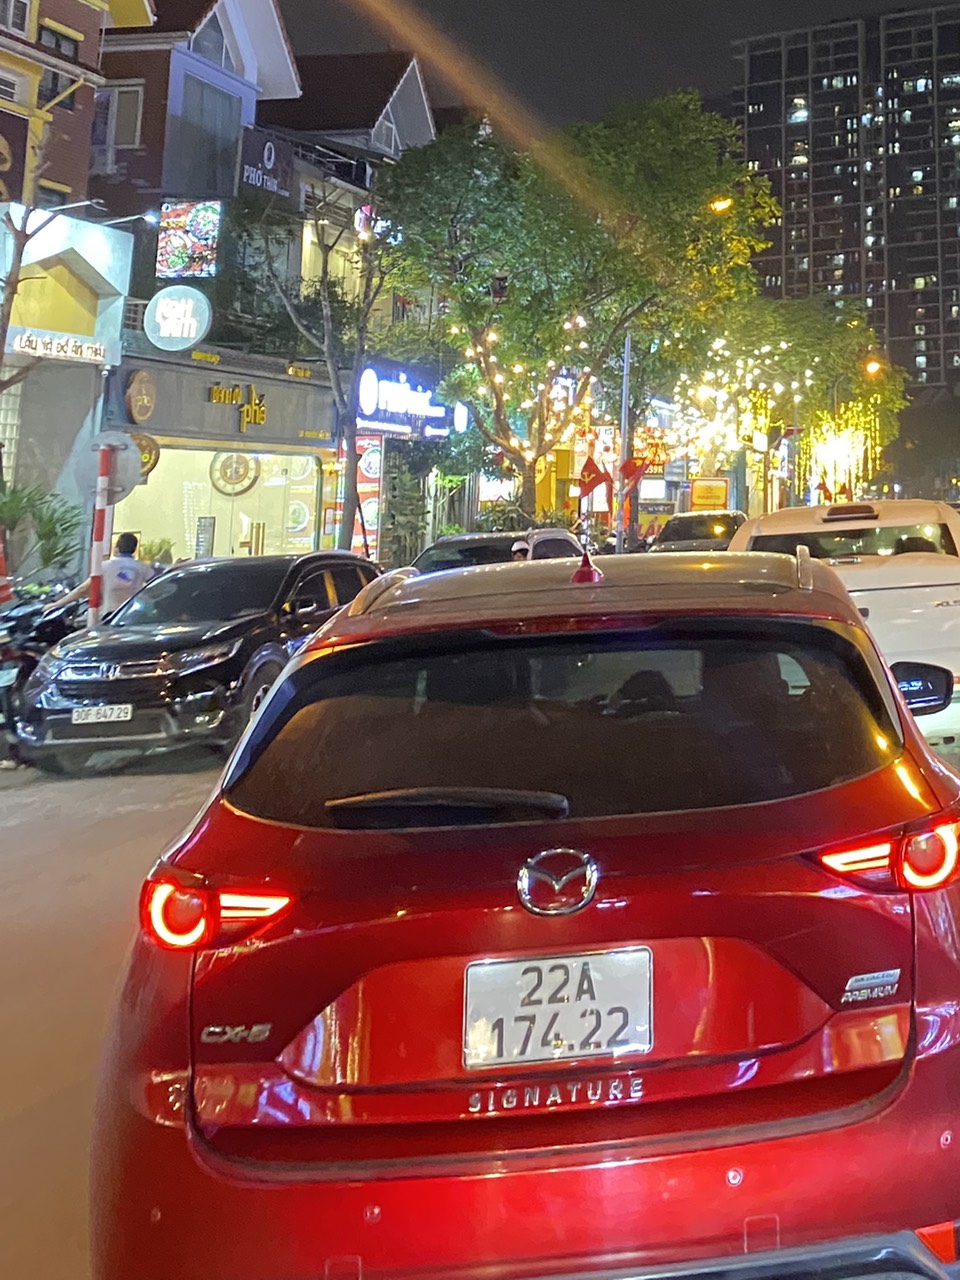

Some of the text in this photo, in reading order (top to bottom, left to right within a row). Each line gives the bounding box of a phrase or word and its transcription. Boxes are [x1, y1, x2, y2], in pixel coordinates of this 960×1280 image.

[520, 961, 597, 1007] 22A
[840, 983, 899, 1004] PREMIUM
[200, 1023, 272, 1044] CX-5
[490, 1006, 631, 1059] 174.22
[467, 1077, 644, 1113] SIGNATURE
